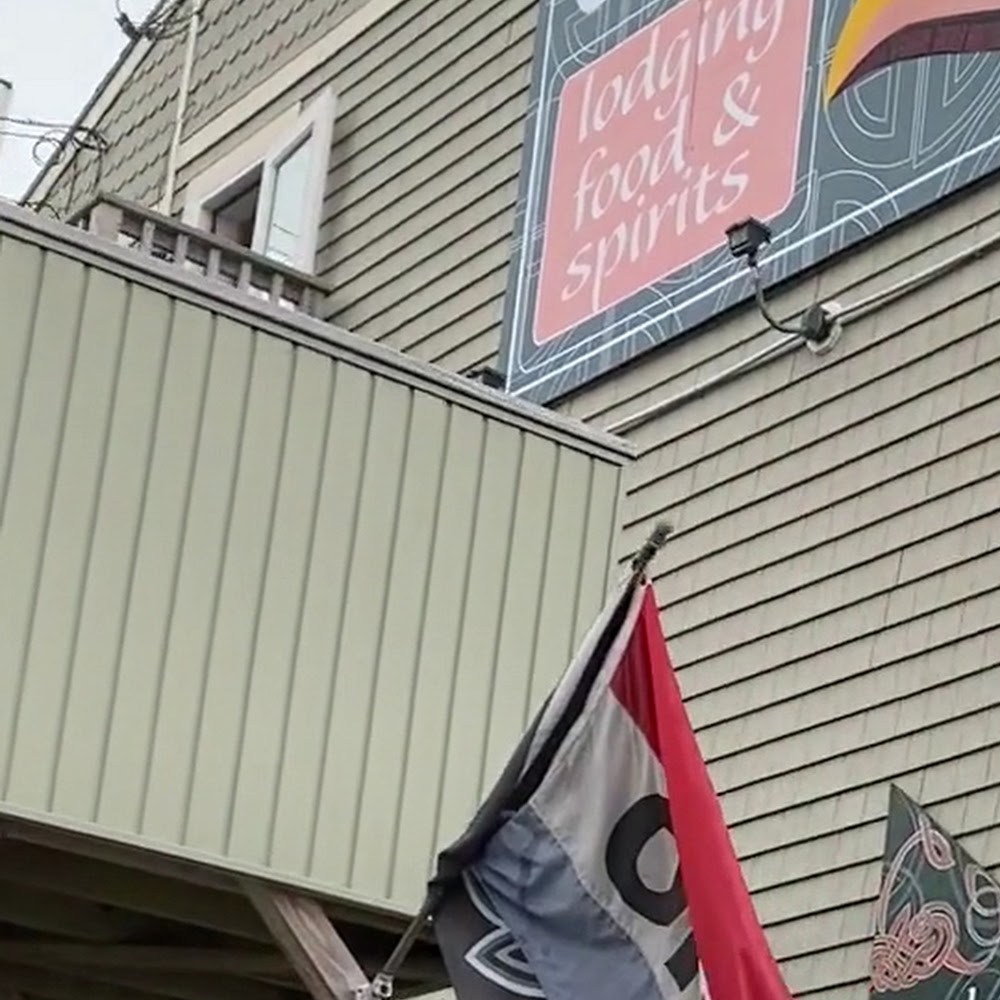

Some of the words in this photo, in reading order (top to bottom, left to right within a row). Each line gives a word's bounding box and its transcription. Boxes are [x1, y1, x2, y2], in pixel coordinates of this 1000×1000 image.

[573, 94, 690, 231] food
[712, 71, 761, 147] &
[578, 0, 784, 143] lodging
[561, 150, 750, 313] spirits
